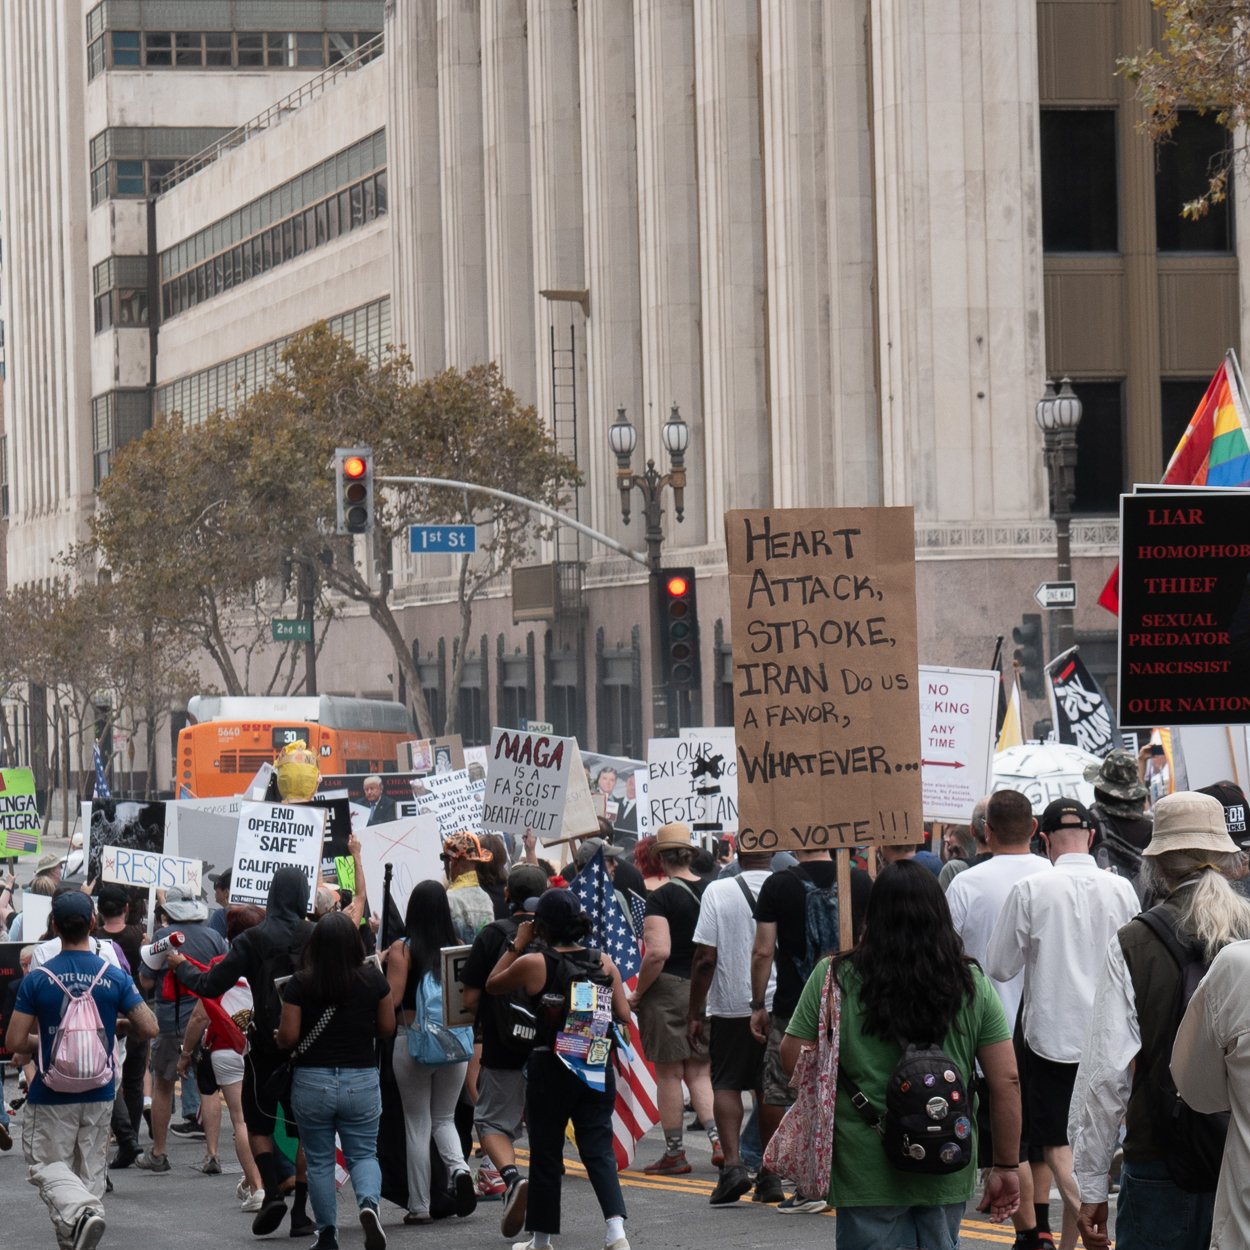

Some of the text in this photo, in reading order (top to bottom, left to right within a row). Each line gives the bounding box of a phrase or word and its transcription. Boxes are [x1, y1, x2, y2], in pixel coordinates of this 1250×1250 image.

[1147, 508, 1205, 526] LIAR
[421, 530, 466, 548] 1st St
[743, 516, 861, 564] HEART
[746, 568, 883, 609] ATTACK,
[1143, 576, 1217, 594] THIEF
[1141, 613, 1217, 628] SEXUAL
[277, 623, 293, 634] 2nd
[747, 616, 897, 653] STROKE,
[1128, 631, 1230, 647] PREDATOR
[1128, 660, 1231, 675] NARCISSIST
[737, 662, 829, 697] IRAN
[928, 684, 949, 696] NO
[934, 701, 970, 715] KING
[1128, 699, 1173, 713] OUR
[743, 701, 851, 728] A FAVOR,
[284, 731, 297, 743] 30
[930, 724, 955, 735] ANY
[928, 737, 956, 749] TIME
[494, 731, 564, 771] MAGA
[514, 766, 539, 780] IS A
[429, 777, 452, 788] First
[493, 778, 561, 800] FASCIST
[417, 794, 439, 805] fuck
[442, 788, 464, 799] your
[438, 793, 472, 808] and the
[513, 796, 539, 807] PEDO
[271, 807, 294, 820] END
[451, 804, 469, 814] you
[440, 821, 458, 831] And
[458, 814, 466, 822] if
[483, 804, 558, 831] DEATH-CULT
[248, 818, 314, 837] OPERATION
[739, 827, 778, 850] GO
[115, 850, 193, 888] RESIST
[236, 877, 270, 891] ICE OU
[47, 972, 76, 985] VOTE
